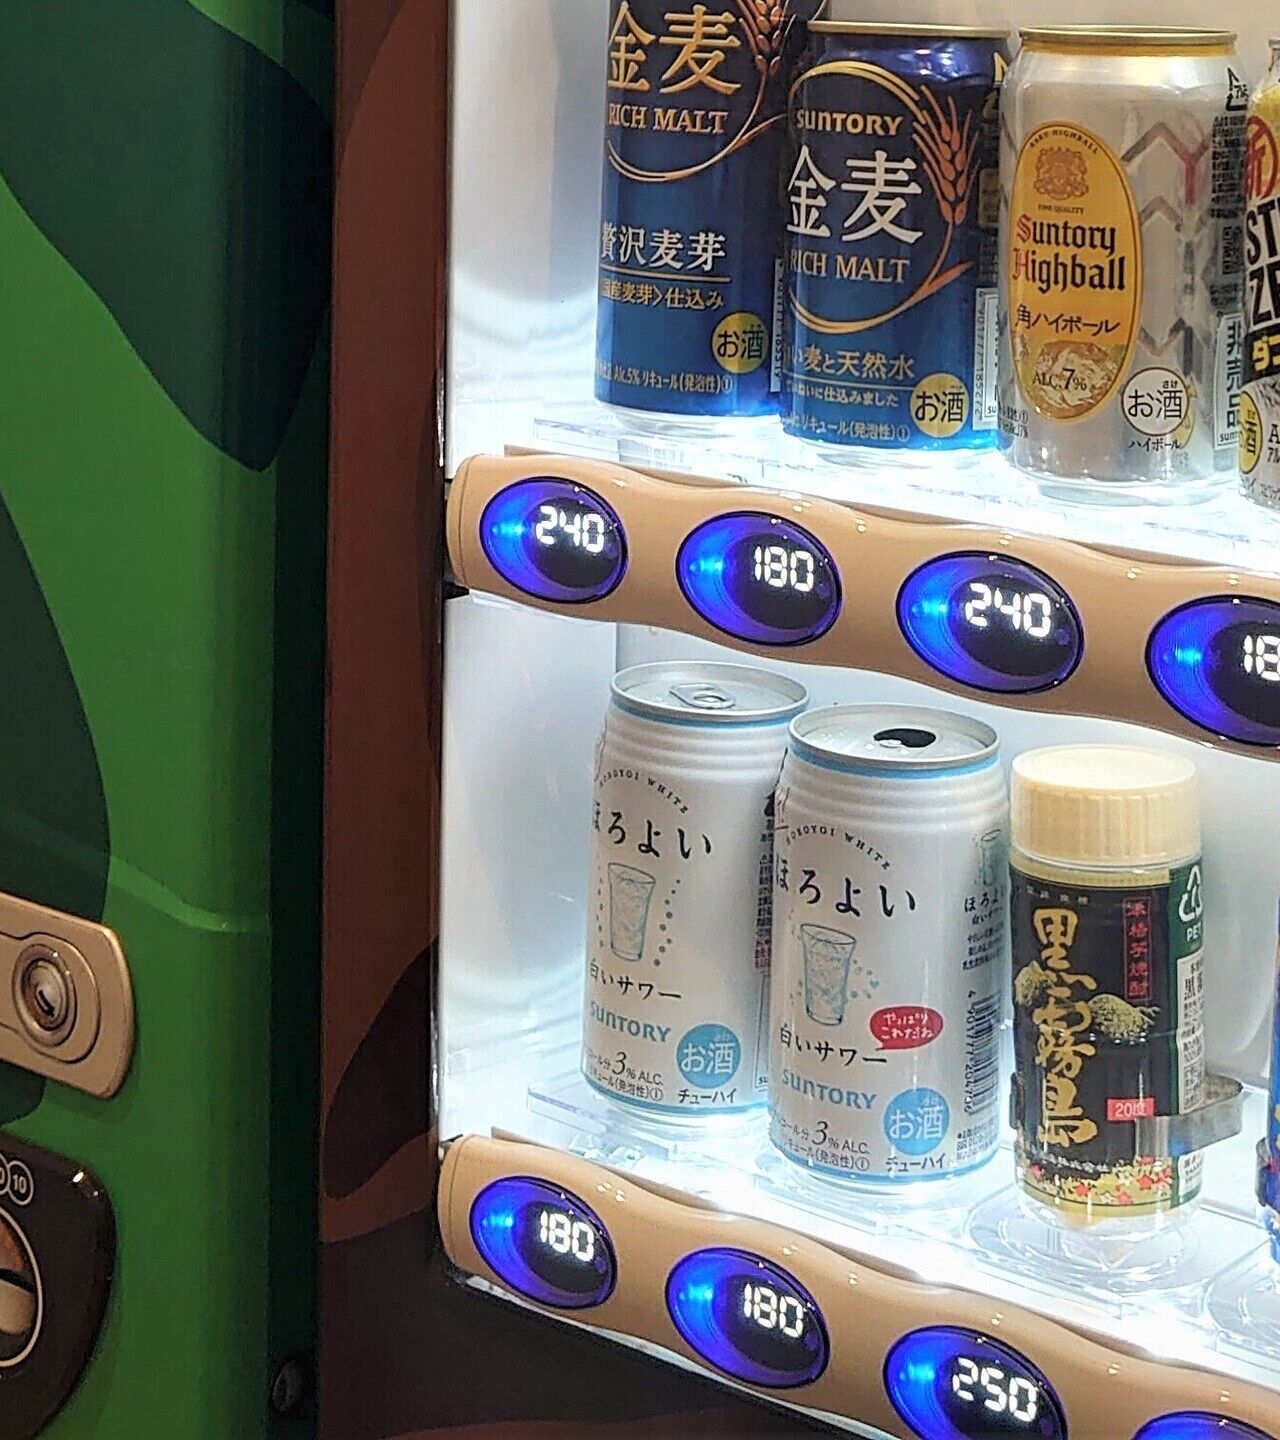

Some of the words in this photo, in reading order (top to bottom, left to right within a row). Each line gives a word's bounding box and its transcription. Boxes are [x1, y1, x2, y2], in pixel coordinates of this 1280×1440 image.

[607, 0, 742, 95] 金麦
[608, 102, 648, 129] RICH
[653, 107, 729, 134] MALT
[786, 144, 924, 245] 金麦
[1016, 213, 1117, 258] Suntory
[790, 246, 828, 277] RICH
[836, 255, 911, 285] MALT
[1013, 247, 1126, 295] Highball
[1014, 304, 1121, 338] 角ハイボール
[716, 328, 765, 360] お酒
[915, 390, 966, 423] お酒
[1126, 388, 1184, 421] お酒
[1128, 438, 1182, 452] ハイボール
[534, 505, 606, 555] 240
[752, 545, 815, 593] 180
[962, 581, 1054, 640] 240
[680, 1040, 736, 1076] お酒
[779, 1024, 888, 1067] 白いサワー
[677, 1087, 737, 1104] チューハイ
[888, 1104, 944, 1141] お酒
[884, 1152, 947, 1174] チューハイ
[12, 1175, 27, 1196] 10
[538, 1210, 596, 1265] 180
[741, 1281, 804, 1339] 180
[951, 1357, 1038, 1423] 250
